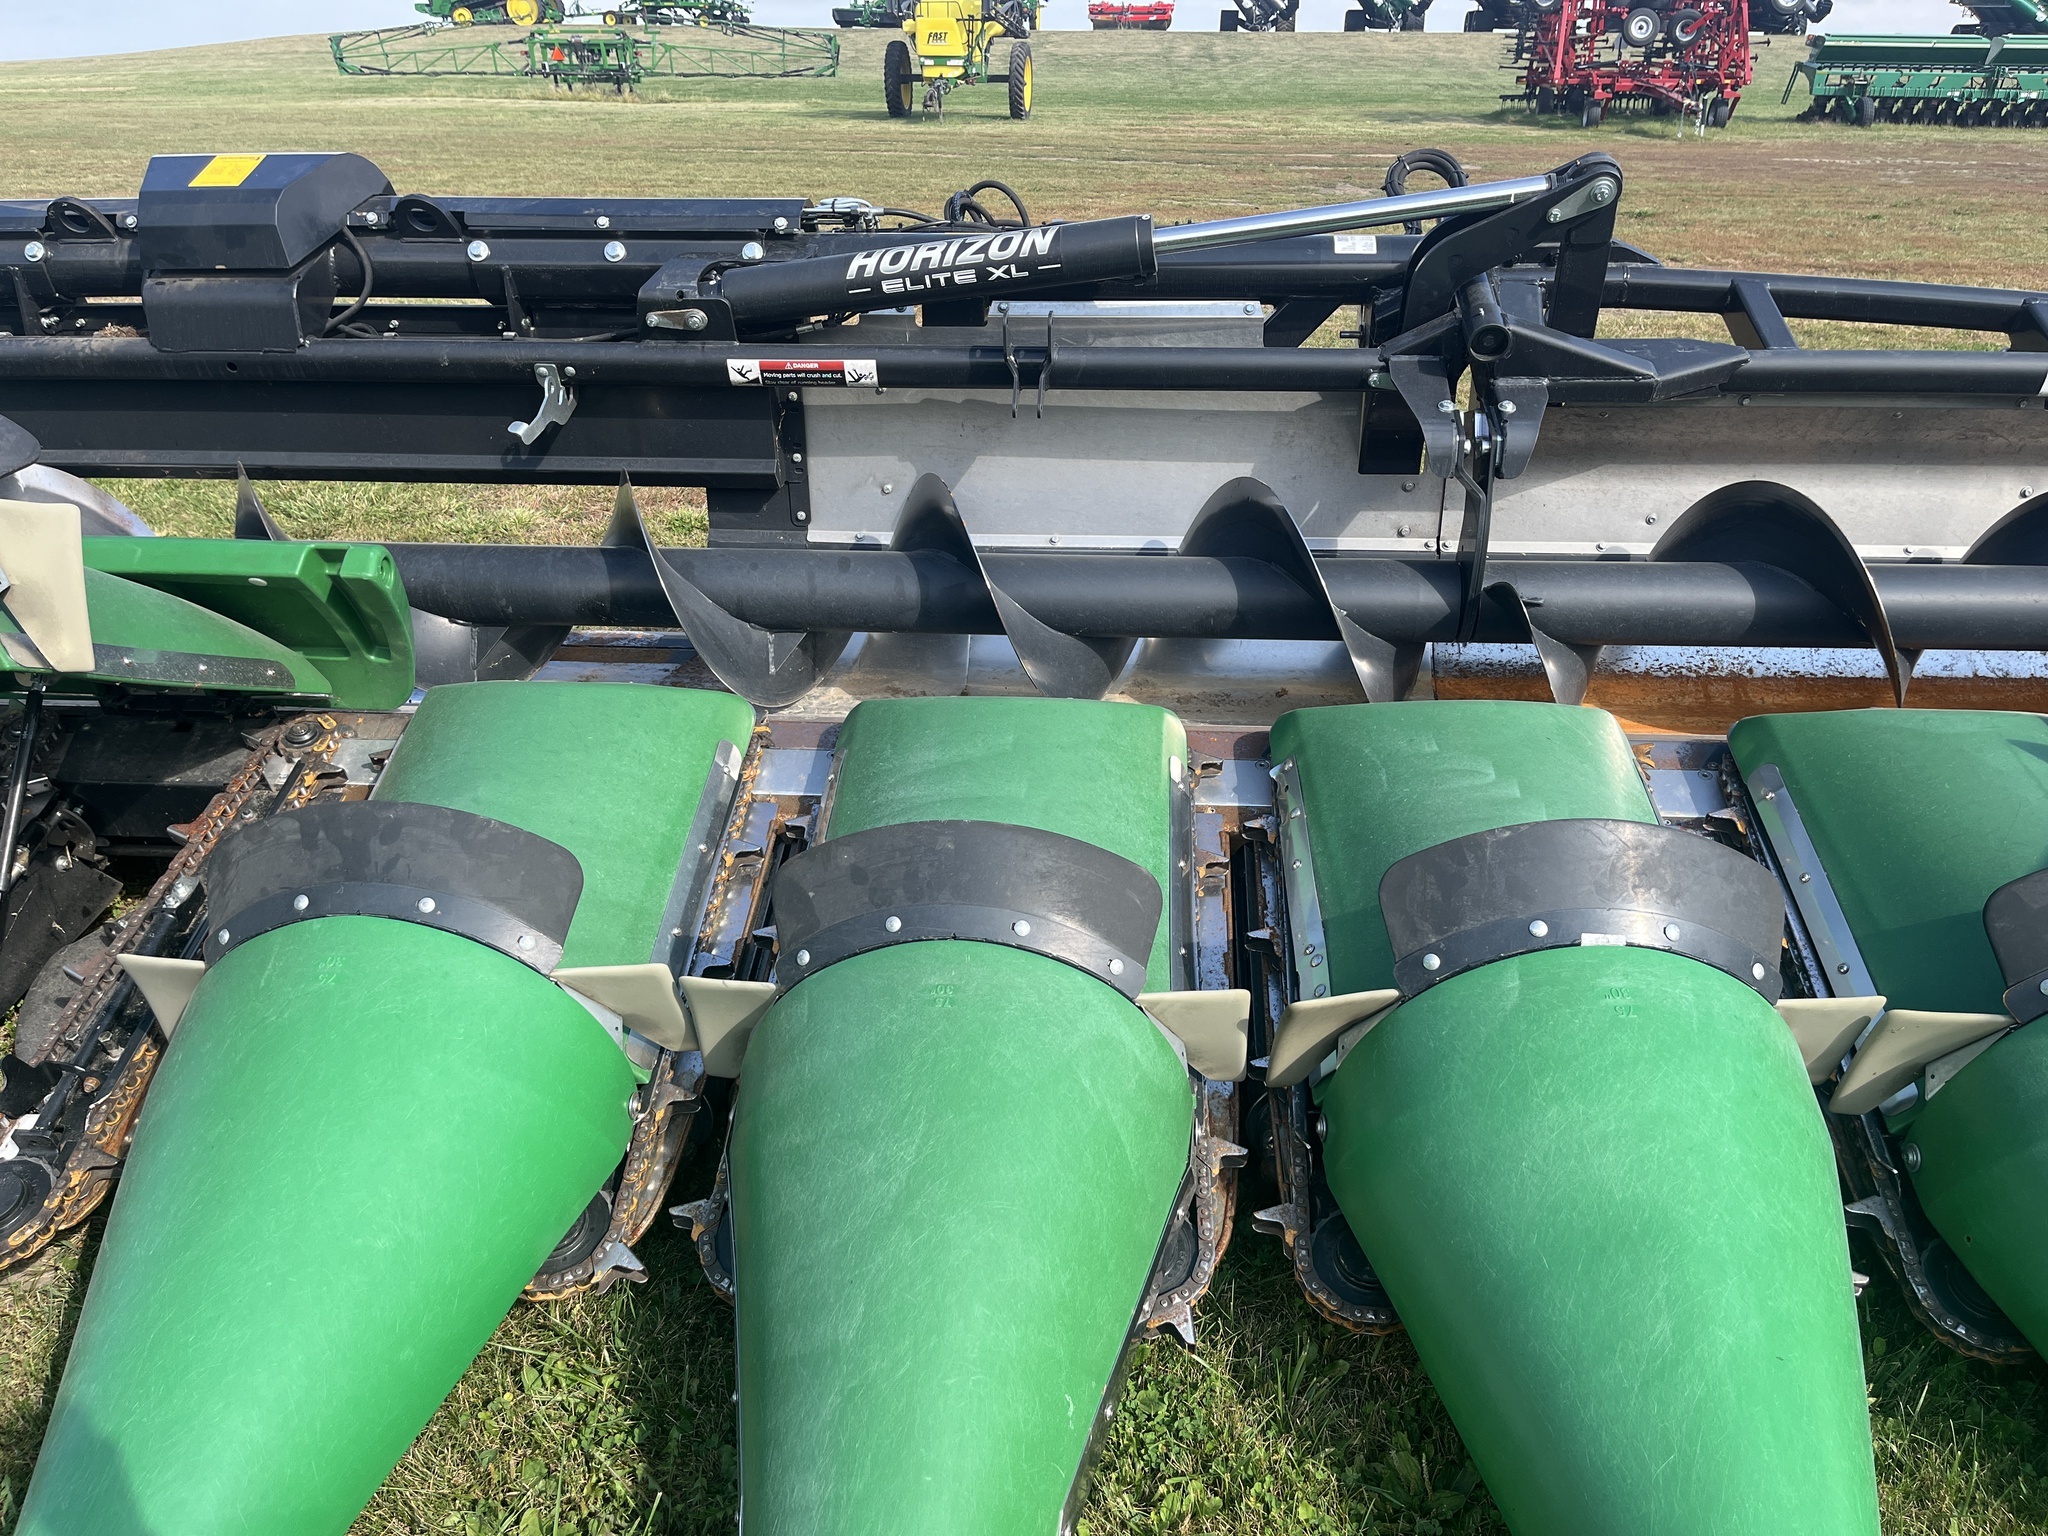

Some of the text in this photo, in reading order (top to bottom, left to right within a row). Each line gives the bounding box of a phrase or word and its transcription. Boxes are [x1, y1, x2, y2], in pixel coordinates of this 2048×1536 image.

[927, 32, 948, 44] FAST
[846, 226, 1059, 279] HORIZON
[881, 264, 1029, 294] ELITE XL
